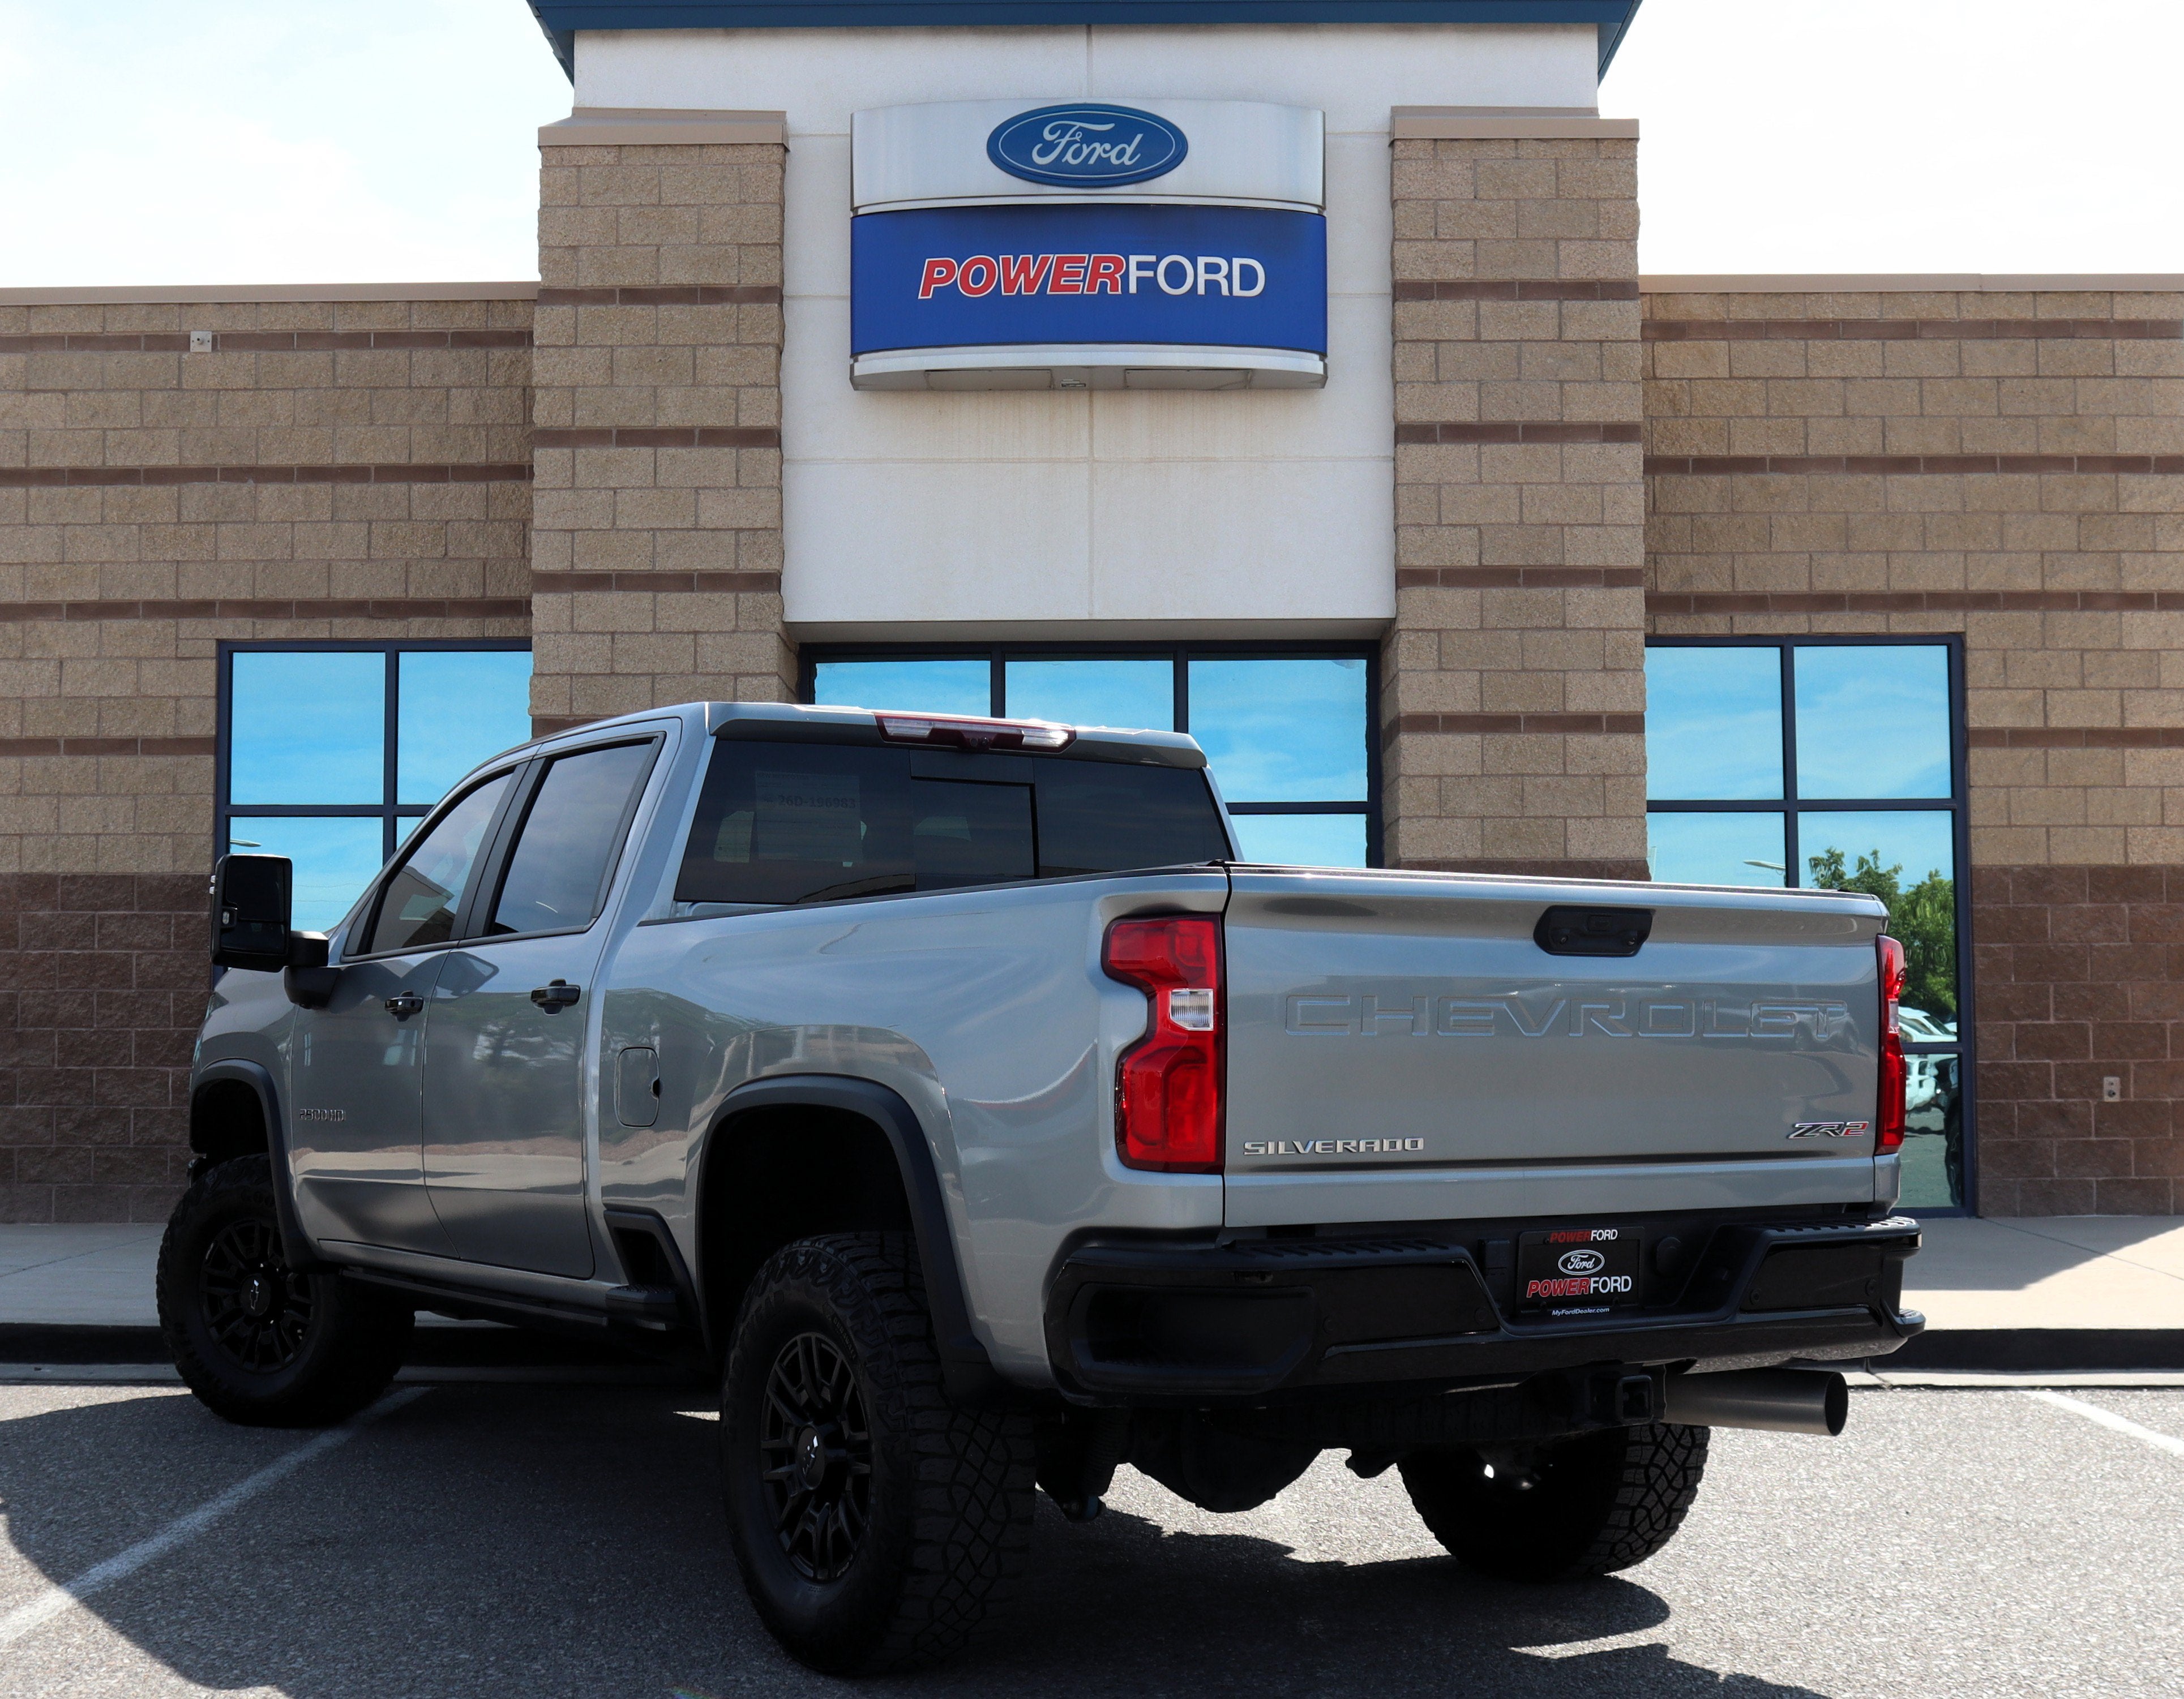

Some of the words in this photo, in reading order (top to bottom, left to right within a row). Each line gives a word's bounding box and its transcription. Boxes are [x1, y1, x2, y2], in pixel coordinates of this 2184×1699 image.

[1031, 120, 1144, 166] Ford
[918, 254, 1266, 299] POWERFORD
[1285, 994, 1848, 1039] CHEVROLET
[1787, 1121, 1870, 1140] ZR2
[1243, 1137, 1425, 1156] SILVERADO
[1549, 1229, 1618, 1243] POWERFORD
[1567, 1254, 1595, 1270] Ford
[1526, 1275, 1632, 1298] POWERFORD
[1552, 1307, 1609, 1316] MyFordDealer.com
